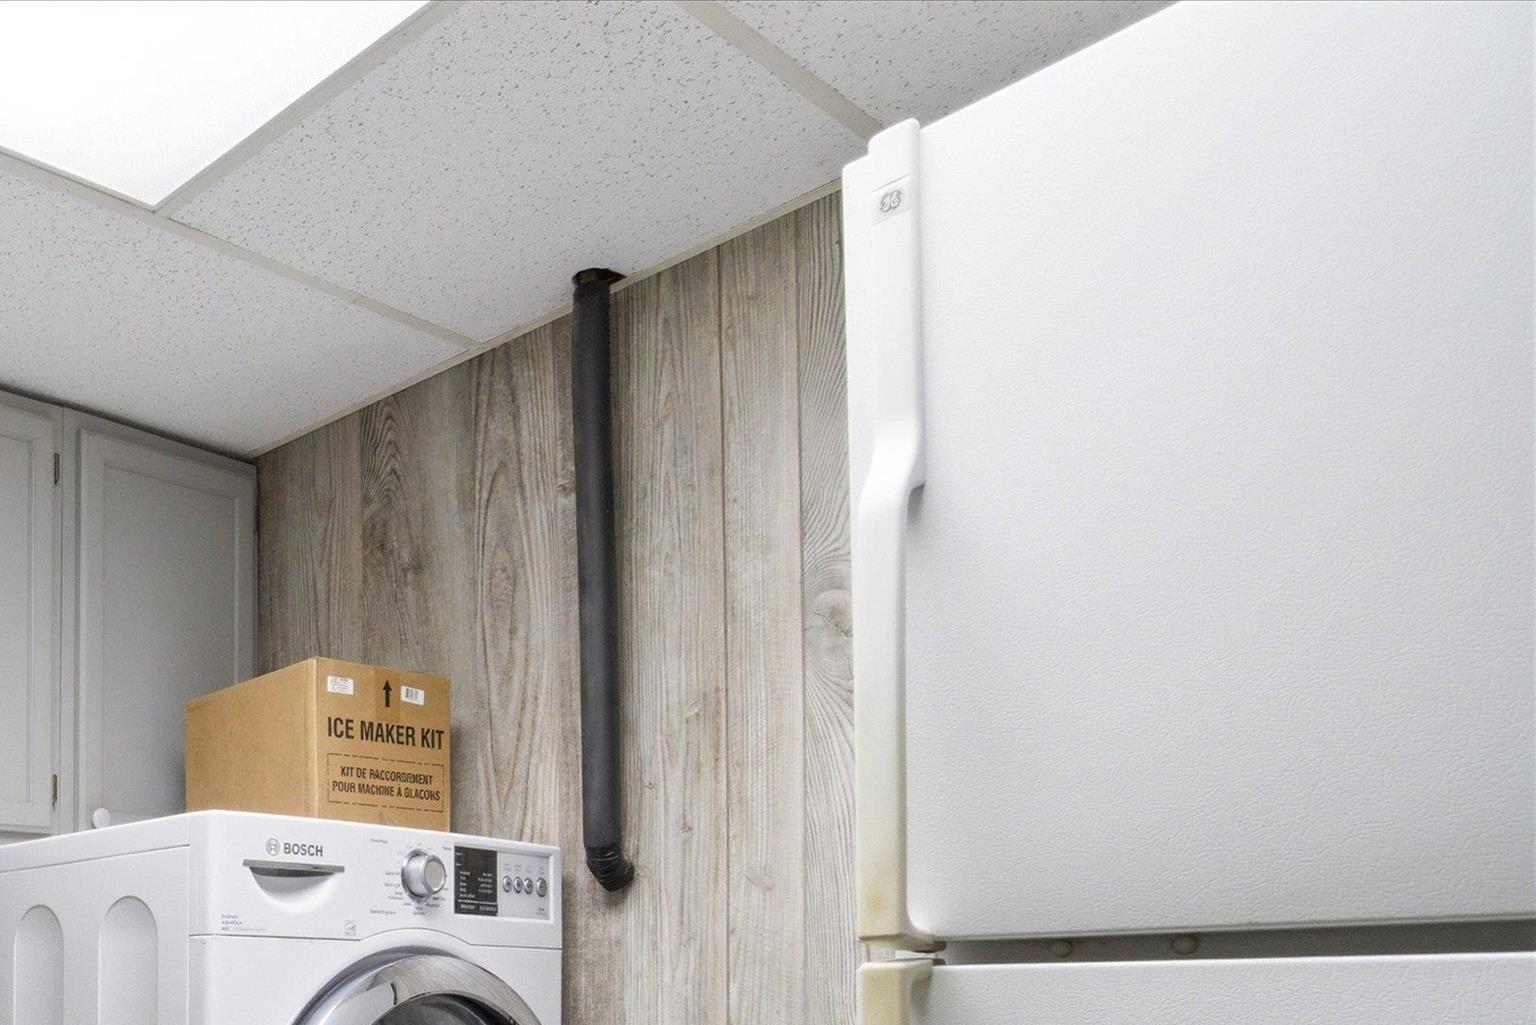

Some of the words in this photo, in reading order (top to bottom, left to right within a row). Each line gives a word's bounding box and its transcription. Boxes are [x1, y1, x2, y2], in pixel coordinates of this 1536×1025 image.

[327, 717, 355, 740] ICE
[360, 720, 416, 747] MAKER
[421, 728, 445, 750] KIT
[340, 766, 354, 777] KIT
[356, 767, 367, 779] DE
[369, 769, 434, 786] RACCORDEMENT
[332, 780, 356, 793] POUR
[358, 783, 395, 797] MACHINE
[283, 842, 324, 857] BOSCH
